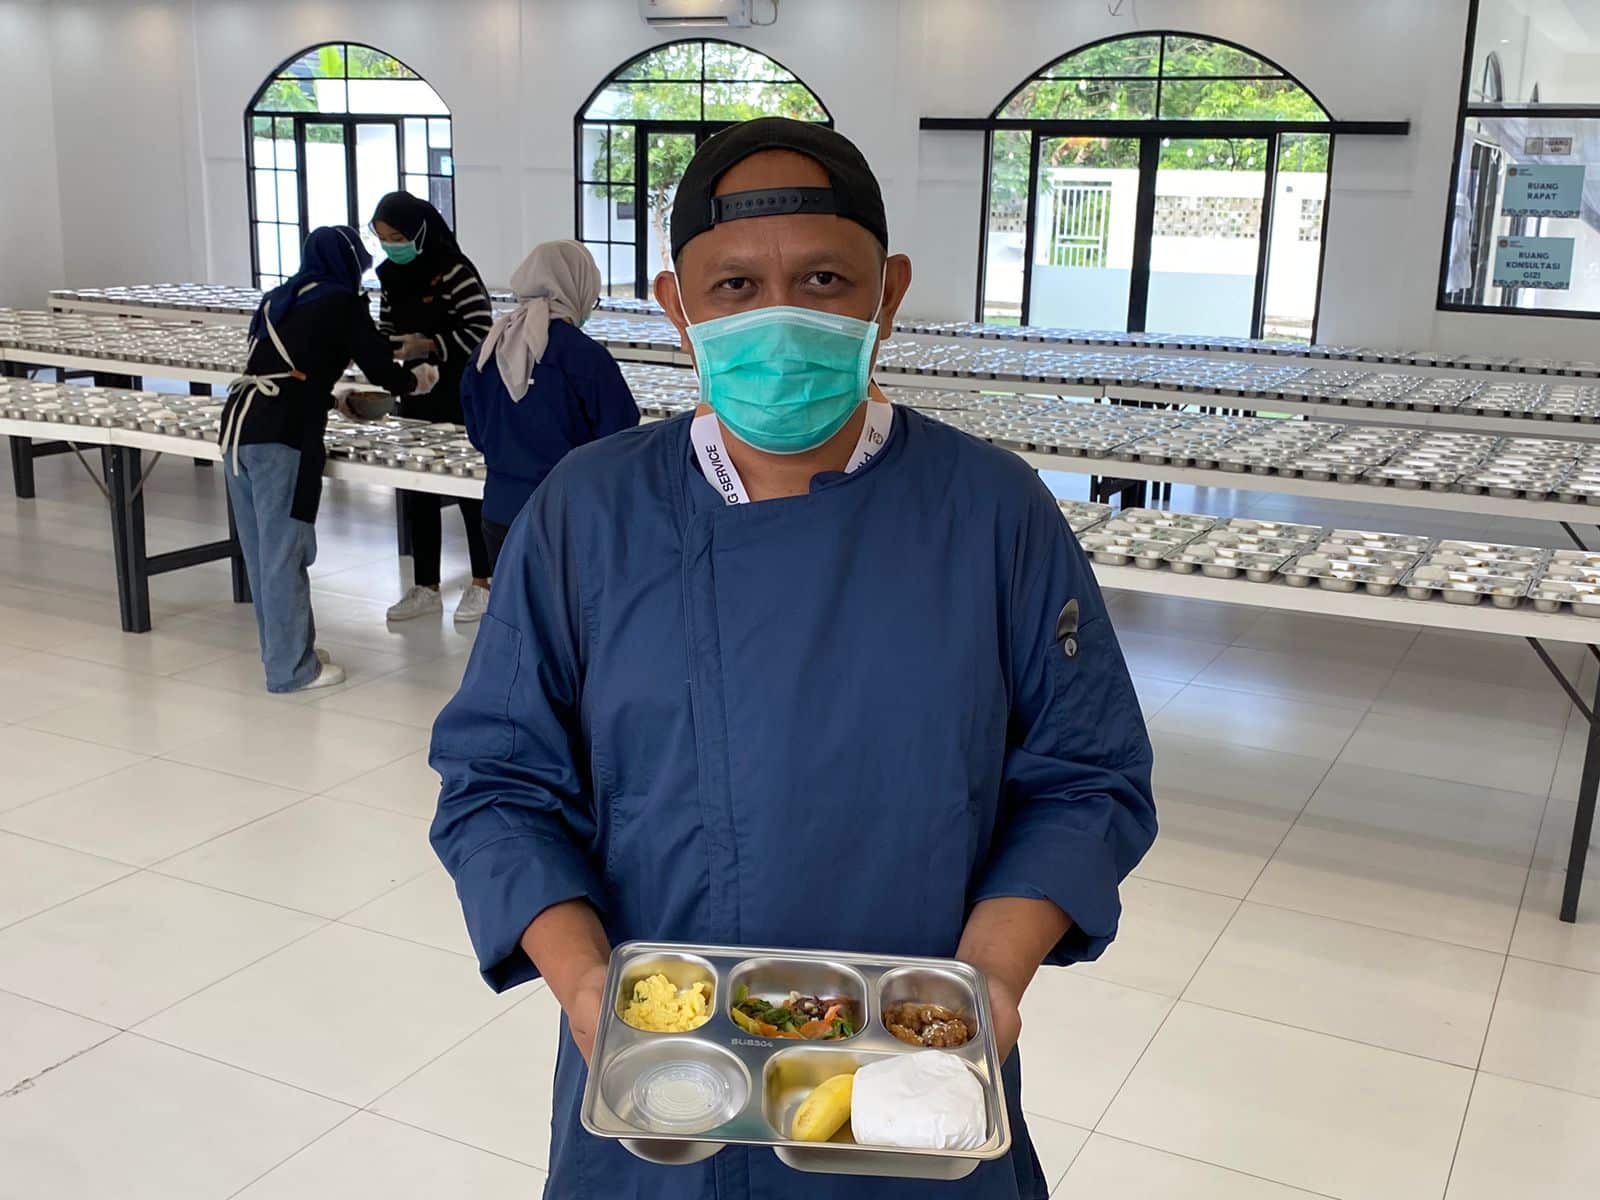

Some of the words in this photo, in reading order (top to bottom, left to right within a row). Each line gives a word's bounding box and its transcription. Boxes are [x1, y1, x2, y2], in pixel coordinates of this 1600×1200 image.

[1527, 182, 1559, 190] RUANG
[1518, 252, 1549, 260] RUANG
[1506, 262, 1561, 270] KONSULTASI
[705, 444, 734, 492] SERVICE
